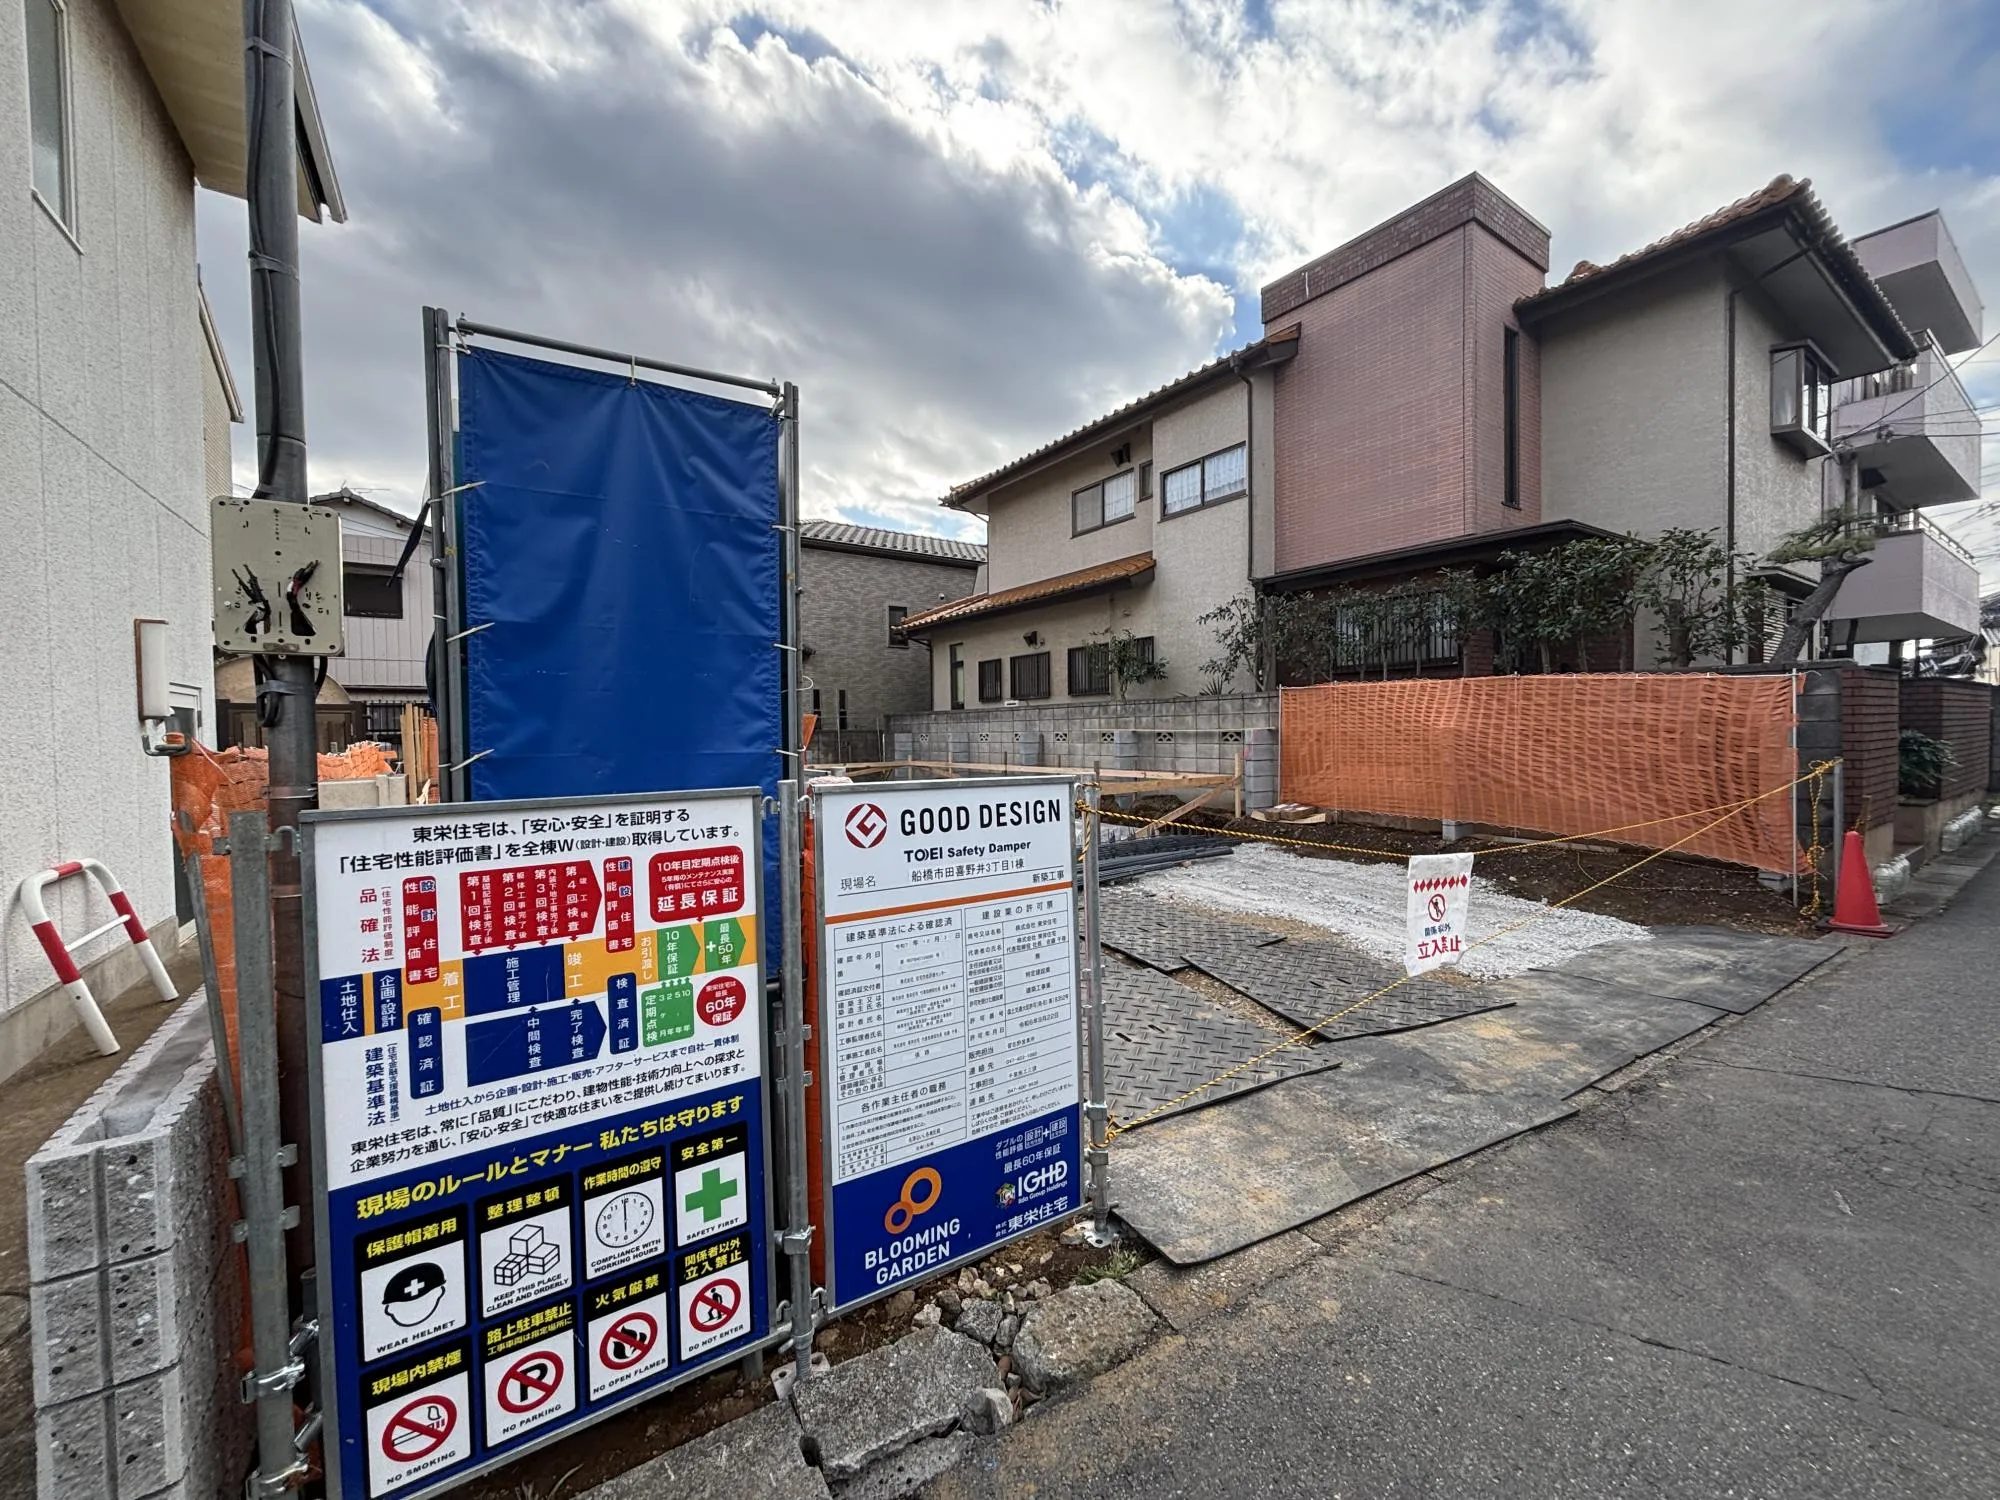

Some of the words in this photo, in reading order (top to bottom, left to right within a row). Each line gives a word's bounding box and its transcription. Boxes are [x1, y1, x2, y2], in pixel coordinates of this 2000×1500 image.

[900, 805, 970, 837] GOOD
[979, 798, 1061, 829] DESIGN
[657, 854, 739, 872] 10年目定期点検後
[947, 844, 985, 858] Safety
[988, 840, 1032, 856] Damper
[840, 875, 876, 890] 現場名
[1032, 870, 1065, 884] 新築工事
[466, 876, 483, 946] 第1回検査
[502, 872, 517, 941] 第2回検査
[534, 869, 549, 936] 第3回検査
[565, 866, 580, 932] 第4回検査
[657, 886, 739, 913] 延長保証
[359, 888, 380, 963] 品確法
[718, 922, 734, 965] 最長50年
[567, 952, 583, 989] 竣工
[641, 936, 653, 980] お引渡し
[664, 930, 680, 975] 10年保証
[442, 970, 461, 1011] 着工
[505, 957, 520, 1004] 施工管理
[340, 980, 358, 1034] 土地仕入
[379, 974, 397, 1027] 企画・設計
[615, 977, 631, 1050] 検査済証
[645, 995, 658, 1042] 定期点検
[705, 996, 737, 1013] 60年
[711, 1010, 733, 1024] 保証
[527, 1017, 542, 1068] 中間検査
[570, 1008, 585, 1059] 完了検査
[417, 1011, 435, 1094] 確認済証
[364, 1046, 386, 1127] 建築基準法
[357, 1141, 593, 1219] 現場のルールとマナー
[599, 1095, 744, 1151] 私たちは守ります
[681, 1136, 738, 1161] 安全第一
[1004, 1143, 1061, 1174] 最長60年保証
[584, 1156, 662, 1191] 作業時間の遵守
[486, 1186, 560, 1220] 整理整頓
[1007, 1196, 1068, 1232] 東栄住宅
[366, 1217, 457, 1259] 保護帽着用
[686, 1226, 716, 1241] SAFETY
[717, 1217, 739, 1230] FIRST
[864, 1218, 960, 1270] BLOOMING
[590, 1244, 641, 1268] COMPLIANCE
[642, 1238, 661, 1249] WITH
[594, 1254, 631, 1274] WORKING
[632, 1246, 658, 1259] HOURS
[684, 1237, 741, 1267] 関係者以外
[684, 1249, 742, 1281] 立入禁止
[876, 1241, 950, 1285] GARDEN
[486, 1299, 514, 1313] CLEAN
[515, 1291, 533, 1304] AND
[533, 1278, 569, 1297] ORDERLY
[493, 1289, 515, 1303] KEEP
[517, 1283, 536, 1295] THIS
[537, 1273, 562, 1288] PLACE
[595, 1273, 659, 1310] 火気厳禁
[376, 1333, 409, 1354] WEAR
[412, 1319, 456, 1342] HELMET
[487, 1302, 572, 1345] 路上駐車禁止
[688, 1343, 700, 1353] DO
[701, 1334, 717, 1347] NOT
[719, 1323, 744, 1339] ENTER
[371, 1349, 462, 1396] 現場内禁煙
[592, 1384, 606, 1395] NO
[608, 1373, 631, 1387] OPEN
[634, 1358, 666, 1377] FLAMES
[502, 1423, 517, 1434] NO
[519, 1403, 562, 1427] PARKING
[386, 1473, 403, 1485] NO
[406, 1450, 456, 1477] SMOKING
